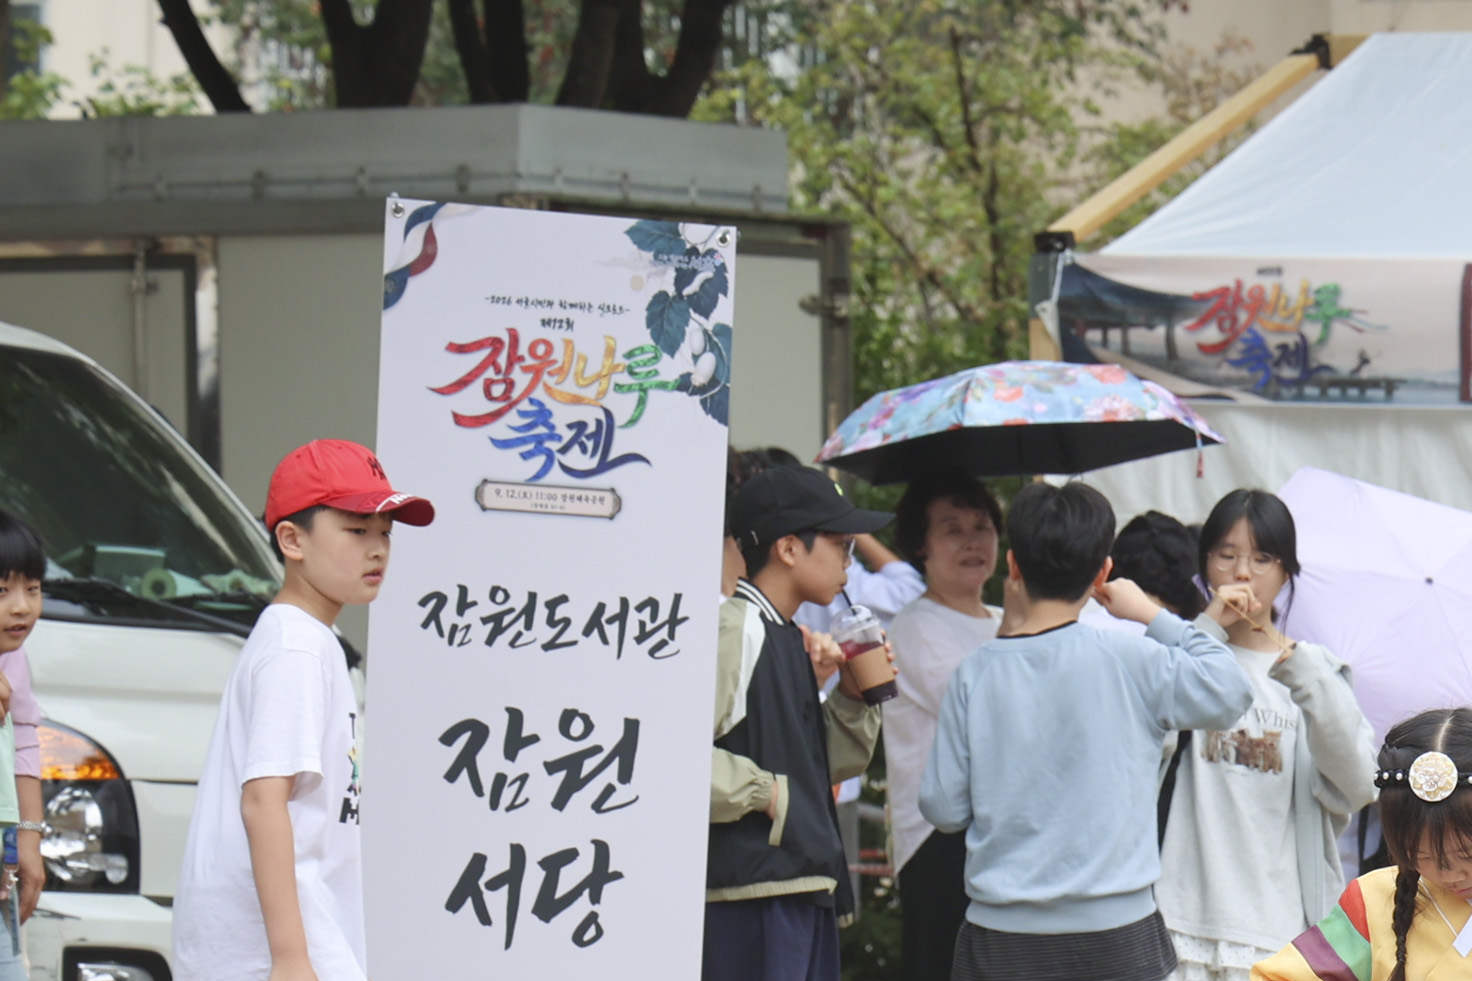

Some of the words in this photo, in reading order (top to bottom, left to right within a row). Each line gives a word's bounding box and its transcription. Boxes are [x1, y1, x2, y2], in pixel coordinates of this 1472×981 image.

[1184, 279, 1346, 353] 잠원나루
[427, 328, 682, 429] 잠원나루
[1226, 328, 1336, 391] 축제
[488, 397, 652, 482] 축제
[418, 584, 690, 659] 잠원도서관
[438, 706, 641, 814] 잠원
[445, 839, 625, 951] 서당
